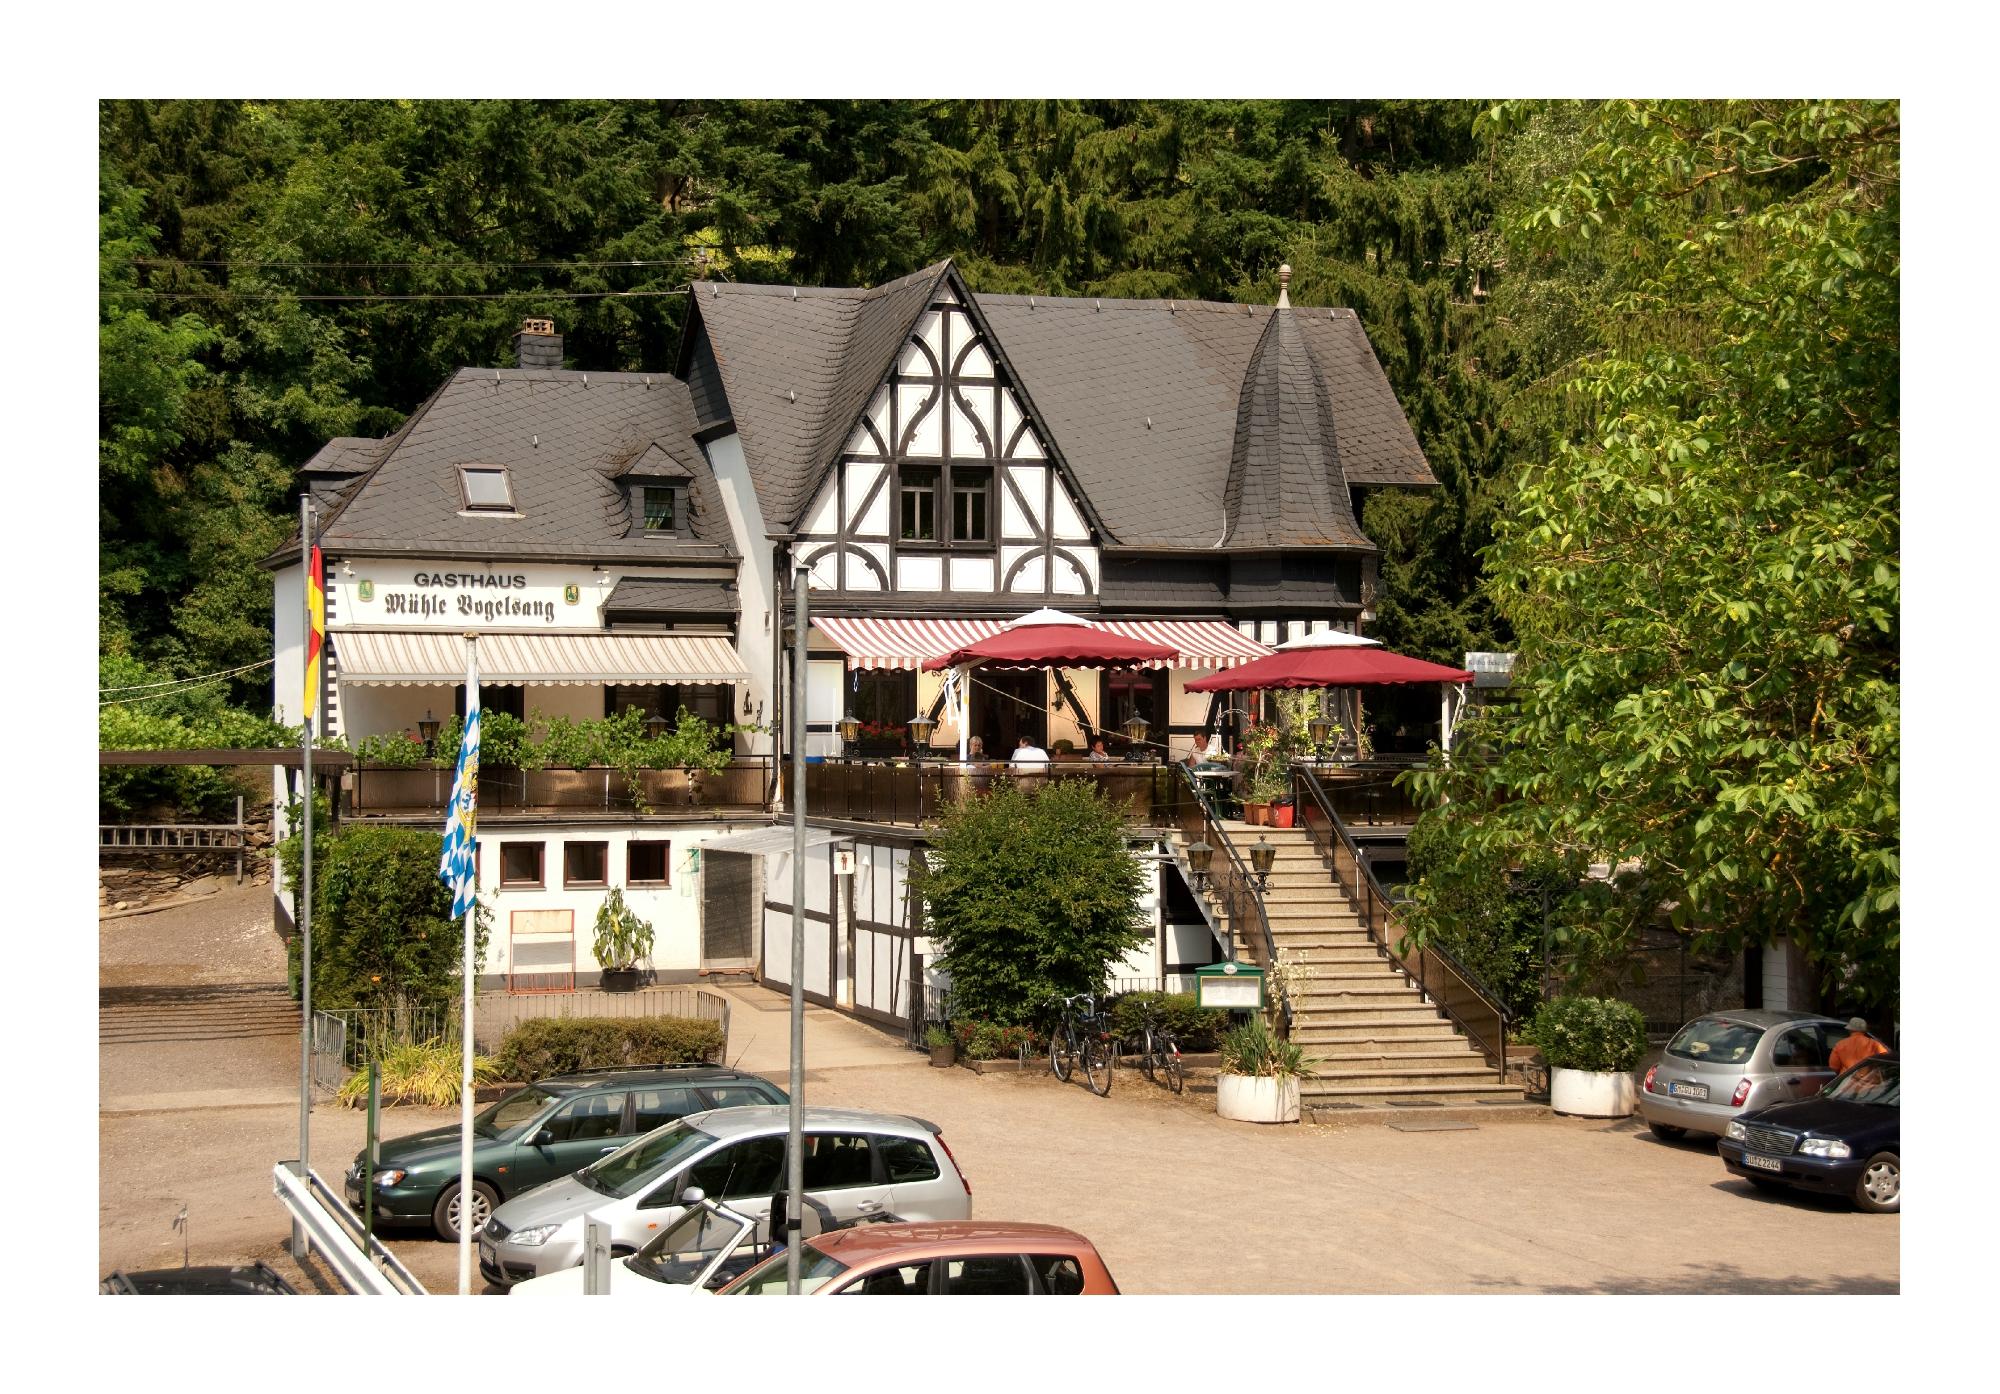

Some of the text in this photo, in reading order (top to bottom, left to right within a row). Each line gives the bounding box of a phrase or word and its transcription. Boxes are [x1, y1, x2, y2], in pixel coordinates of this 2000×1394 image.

[414, 573, 527, 589] GASTHAUS
[384, 593, 556, 623] Mühle Vogelsang
